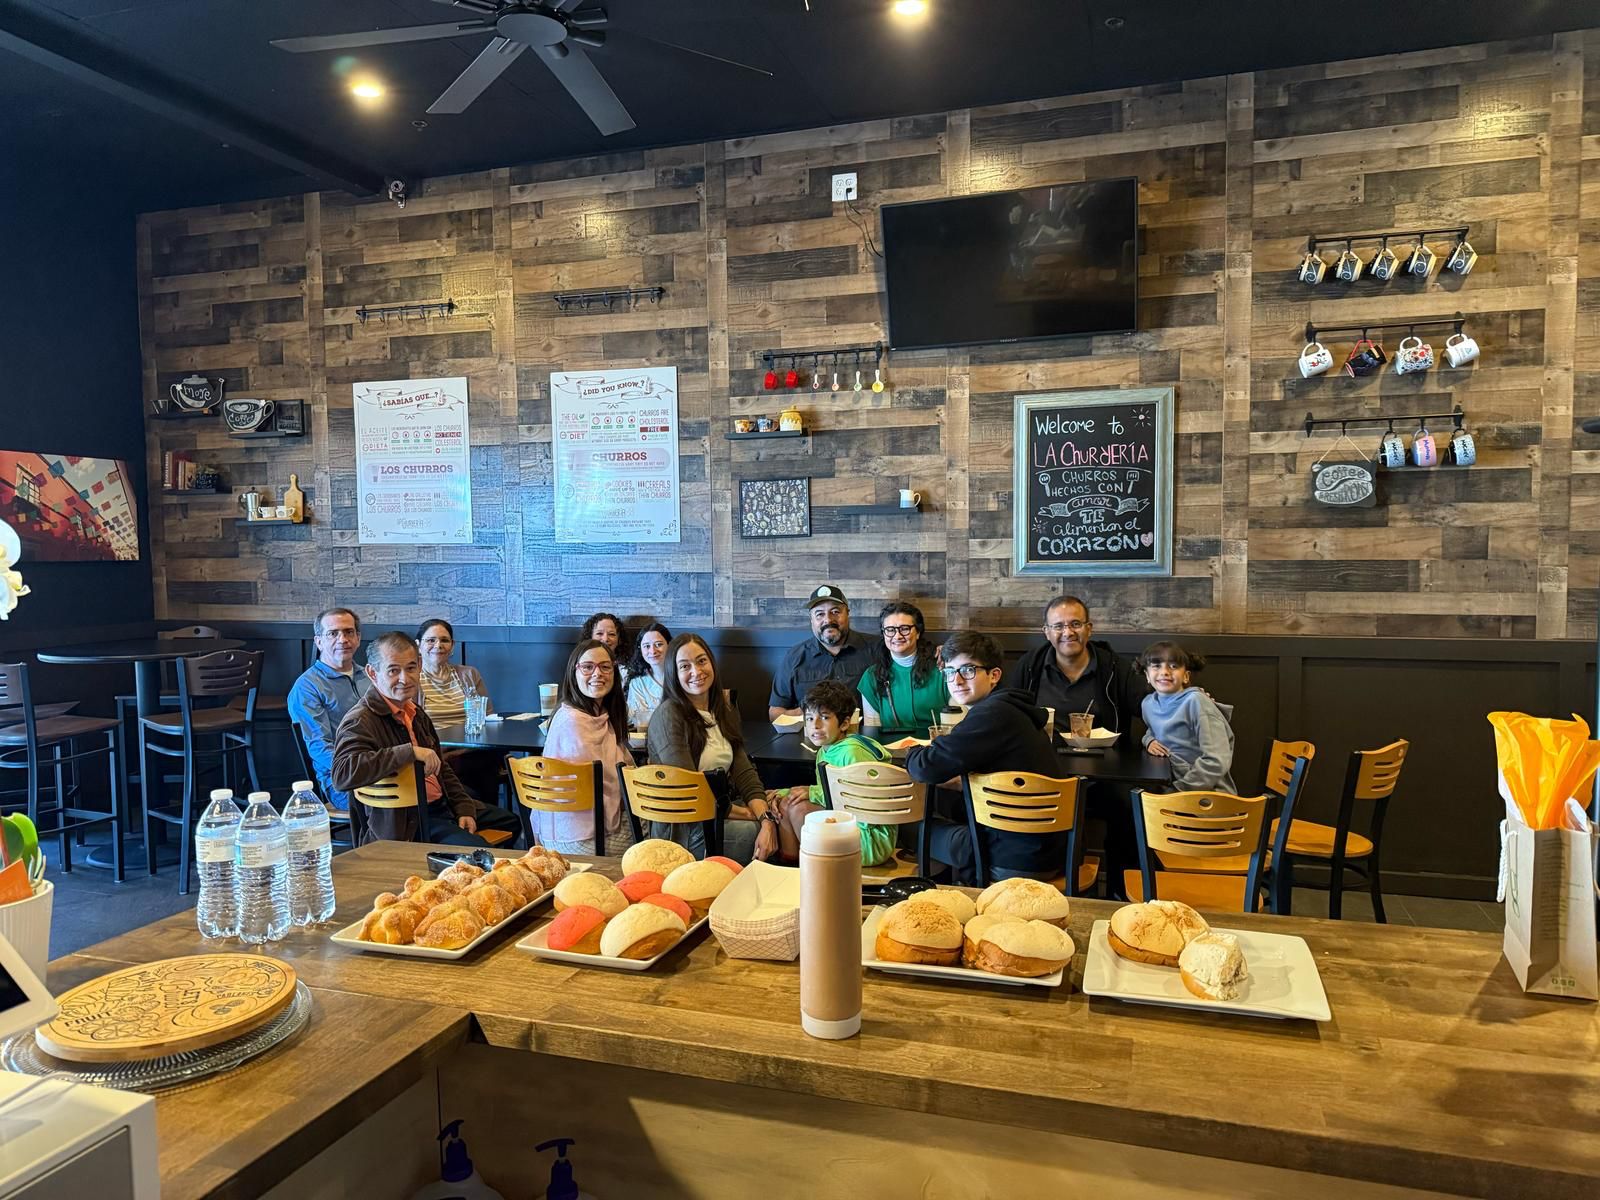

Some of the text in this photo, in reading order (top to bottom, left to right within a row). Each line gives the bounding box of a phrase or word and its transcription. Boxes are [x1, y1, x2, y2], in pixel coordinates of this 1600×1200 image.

[583, 388, 600, 396] ¿DID
[601, 385, 615, 393] YOU
[382, 396, 414, 407] ¿SABÍAS
[1035, 413, 1125, 436] Welcome to
[369, 442, 388, 450] DIETA
[592, 451, 648, 462] CHURROS
[1034, 441, 1057, 468] LA
[380, 464, 454, 475] LOS CHURROS
[1062, 470, 1117, 484] CHURROS
[644, 480, 671, 489] CEREALS
[1051, 482, 1124, 497] HECHOS CON
[650, 491, 672, 499] CHURROS
[377, 504, 401, 514] CHURROS
[1079, 509, 1105, 524] TE
[1124, 517, 1142, 530] el
[1037, 532, 1140, 556] CORAZÓN
